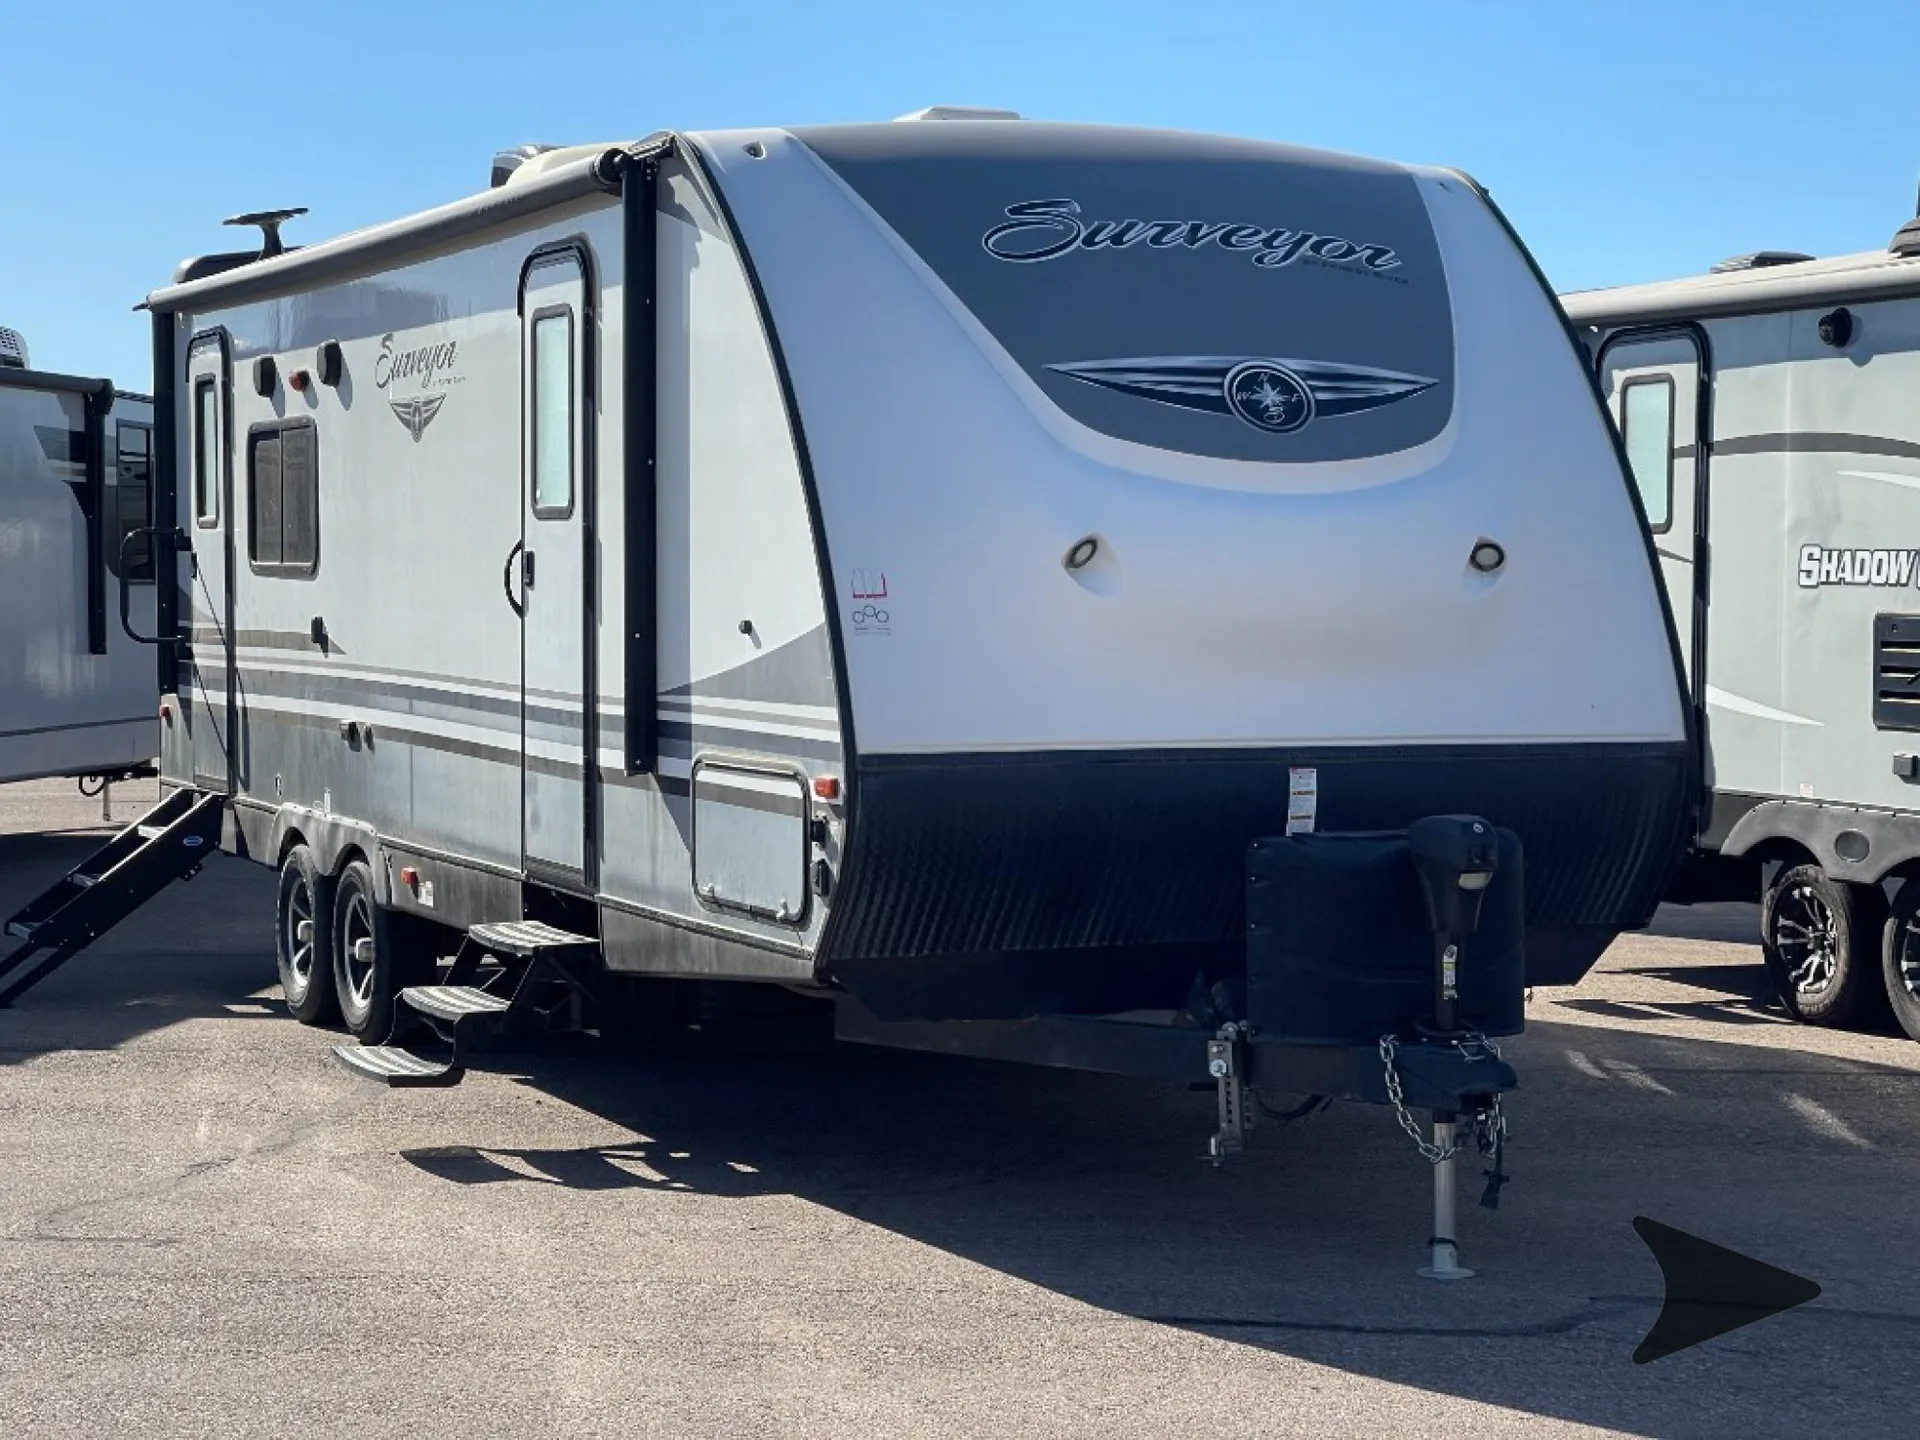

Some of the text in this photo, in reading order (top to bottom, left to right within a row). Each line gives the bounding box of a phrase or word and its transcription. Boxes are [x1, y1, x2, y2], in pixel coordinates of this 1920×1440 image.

[982, 198, 1402, 271] Surveyor
[375, 332, 457, 389] Surveyor
[1798, 544, 1915, 588] SHADOW
